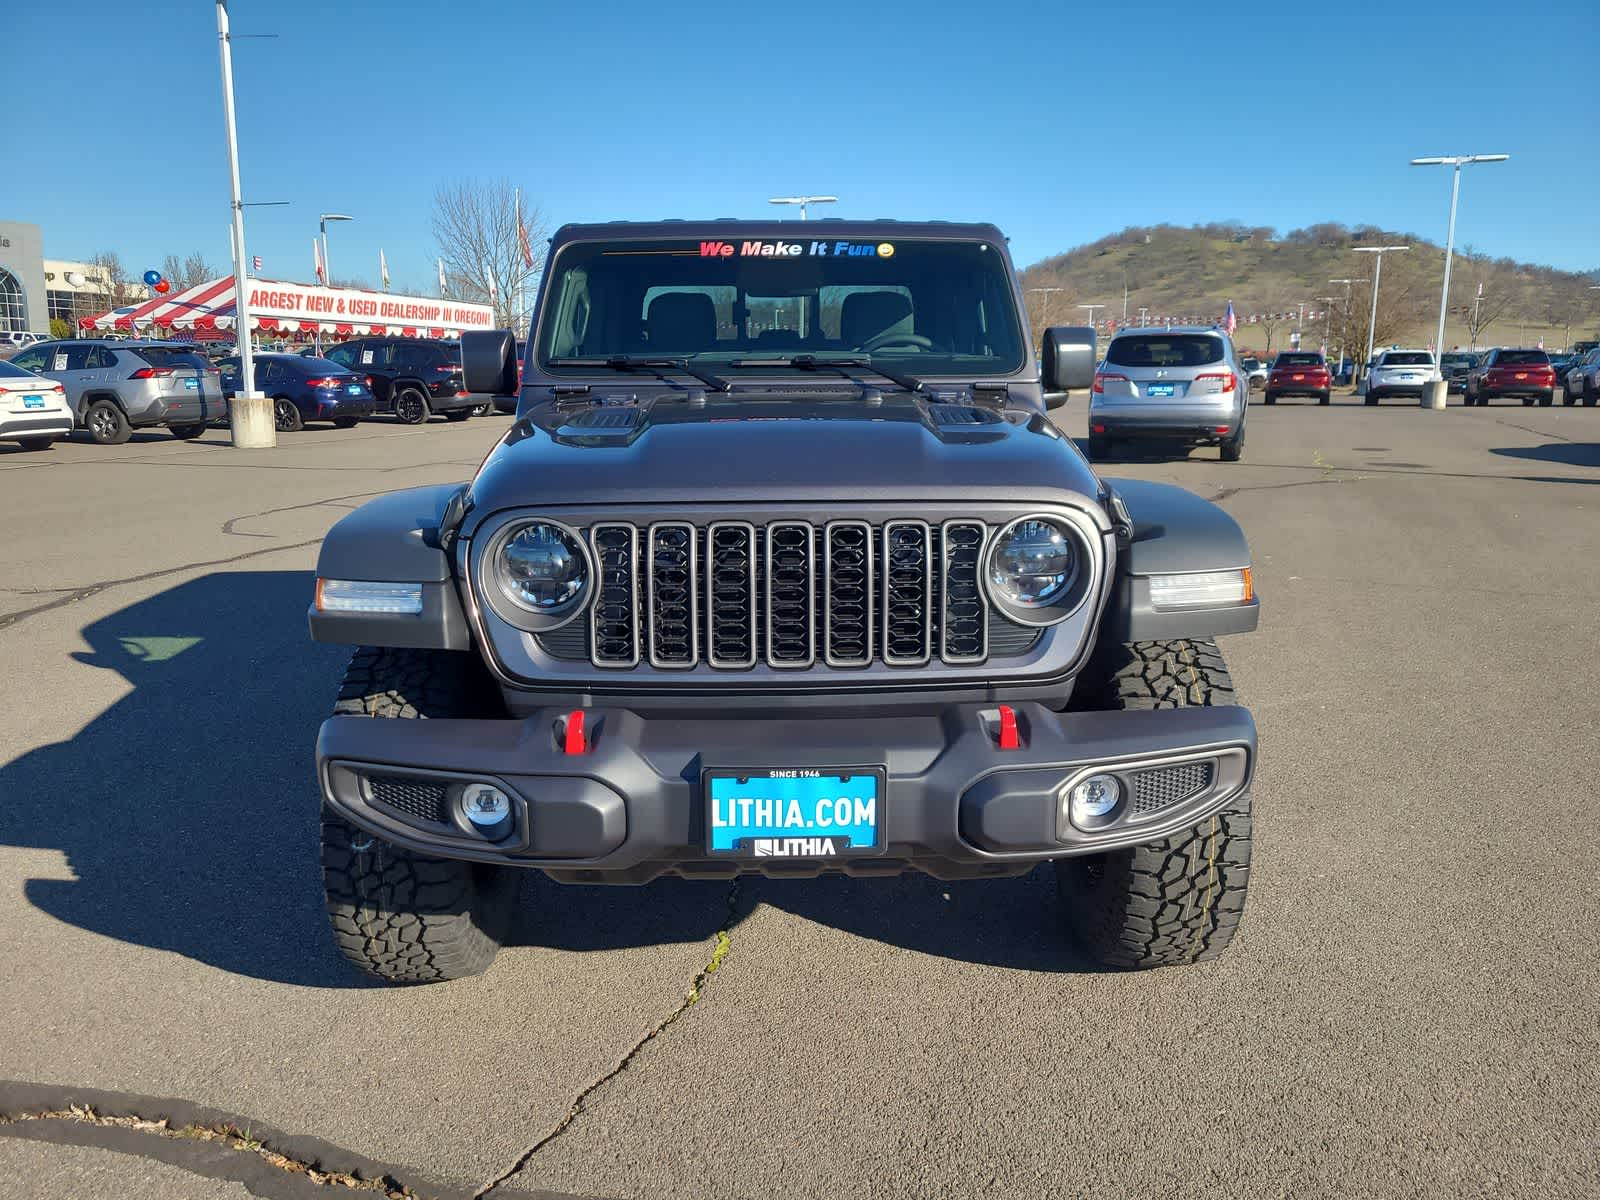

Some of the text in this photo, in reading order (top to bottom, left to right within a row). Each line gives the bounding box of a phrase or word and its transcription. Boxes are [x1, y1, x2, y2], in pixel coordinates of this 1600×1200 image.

[700, 241, 876, 257] We Make It Fun
[248, 289, 491, 327] ARGEST NEW & USED DEALERSHIP IN OREGON!
[769, 770, 797, 778] SINCE
[712, 797, 876, 828] LITHIA.COM
[772, 838, 836, 856] LITHIA
